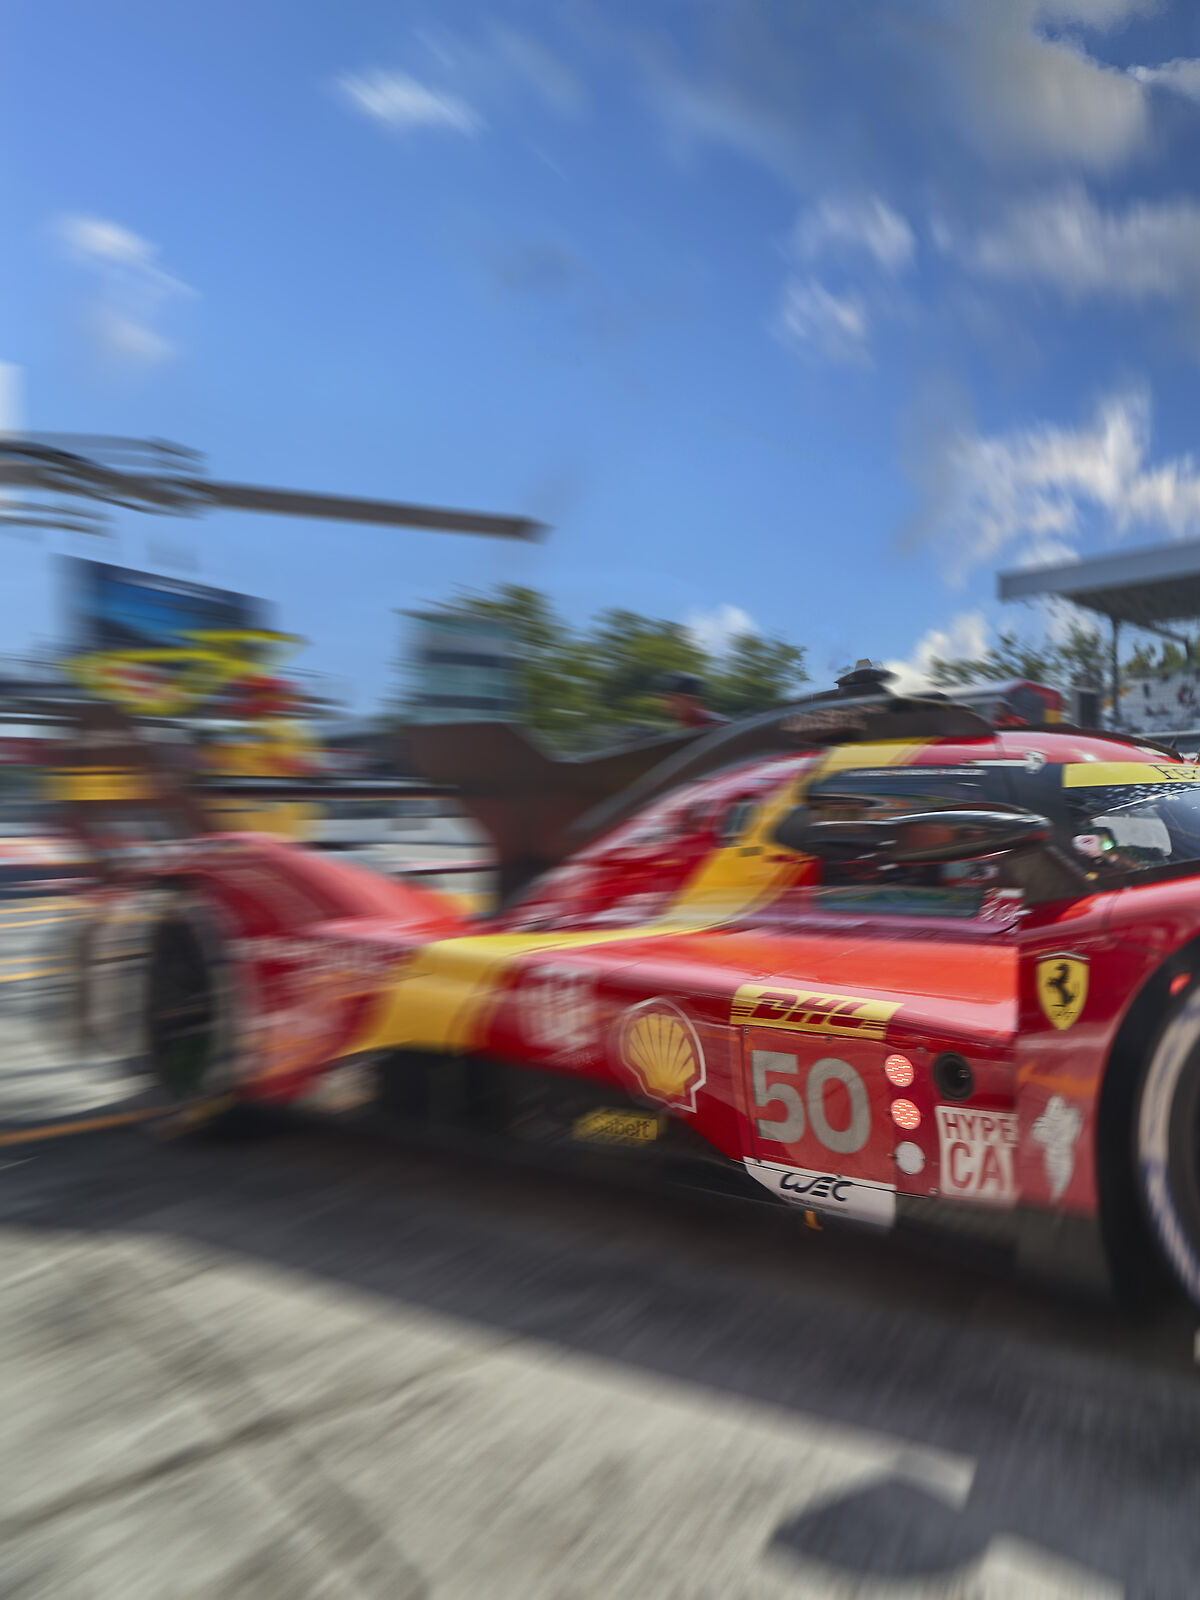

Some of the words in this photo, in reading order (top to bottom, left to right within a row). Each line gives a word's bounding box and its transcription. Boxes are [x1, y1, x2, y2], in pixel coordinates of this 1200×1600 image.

[750, 992, 867, 1029] DHL
[751, 1050, 871, 1154] 50
[780, 1172, 853, 1202] WEC
